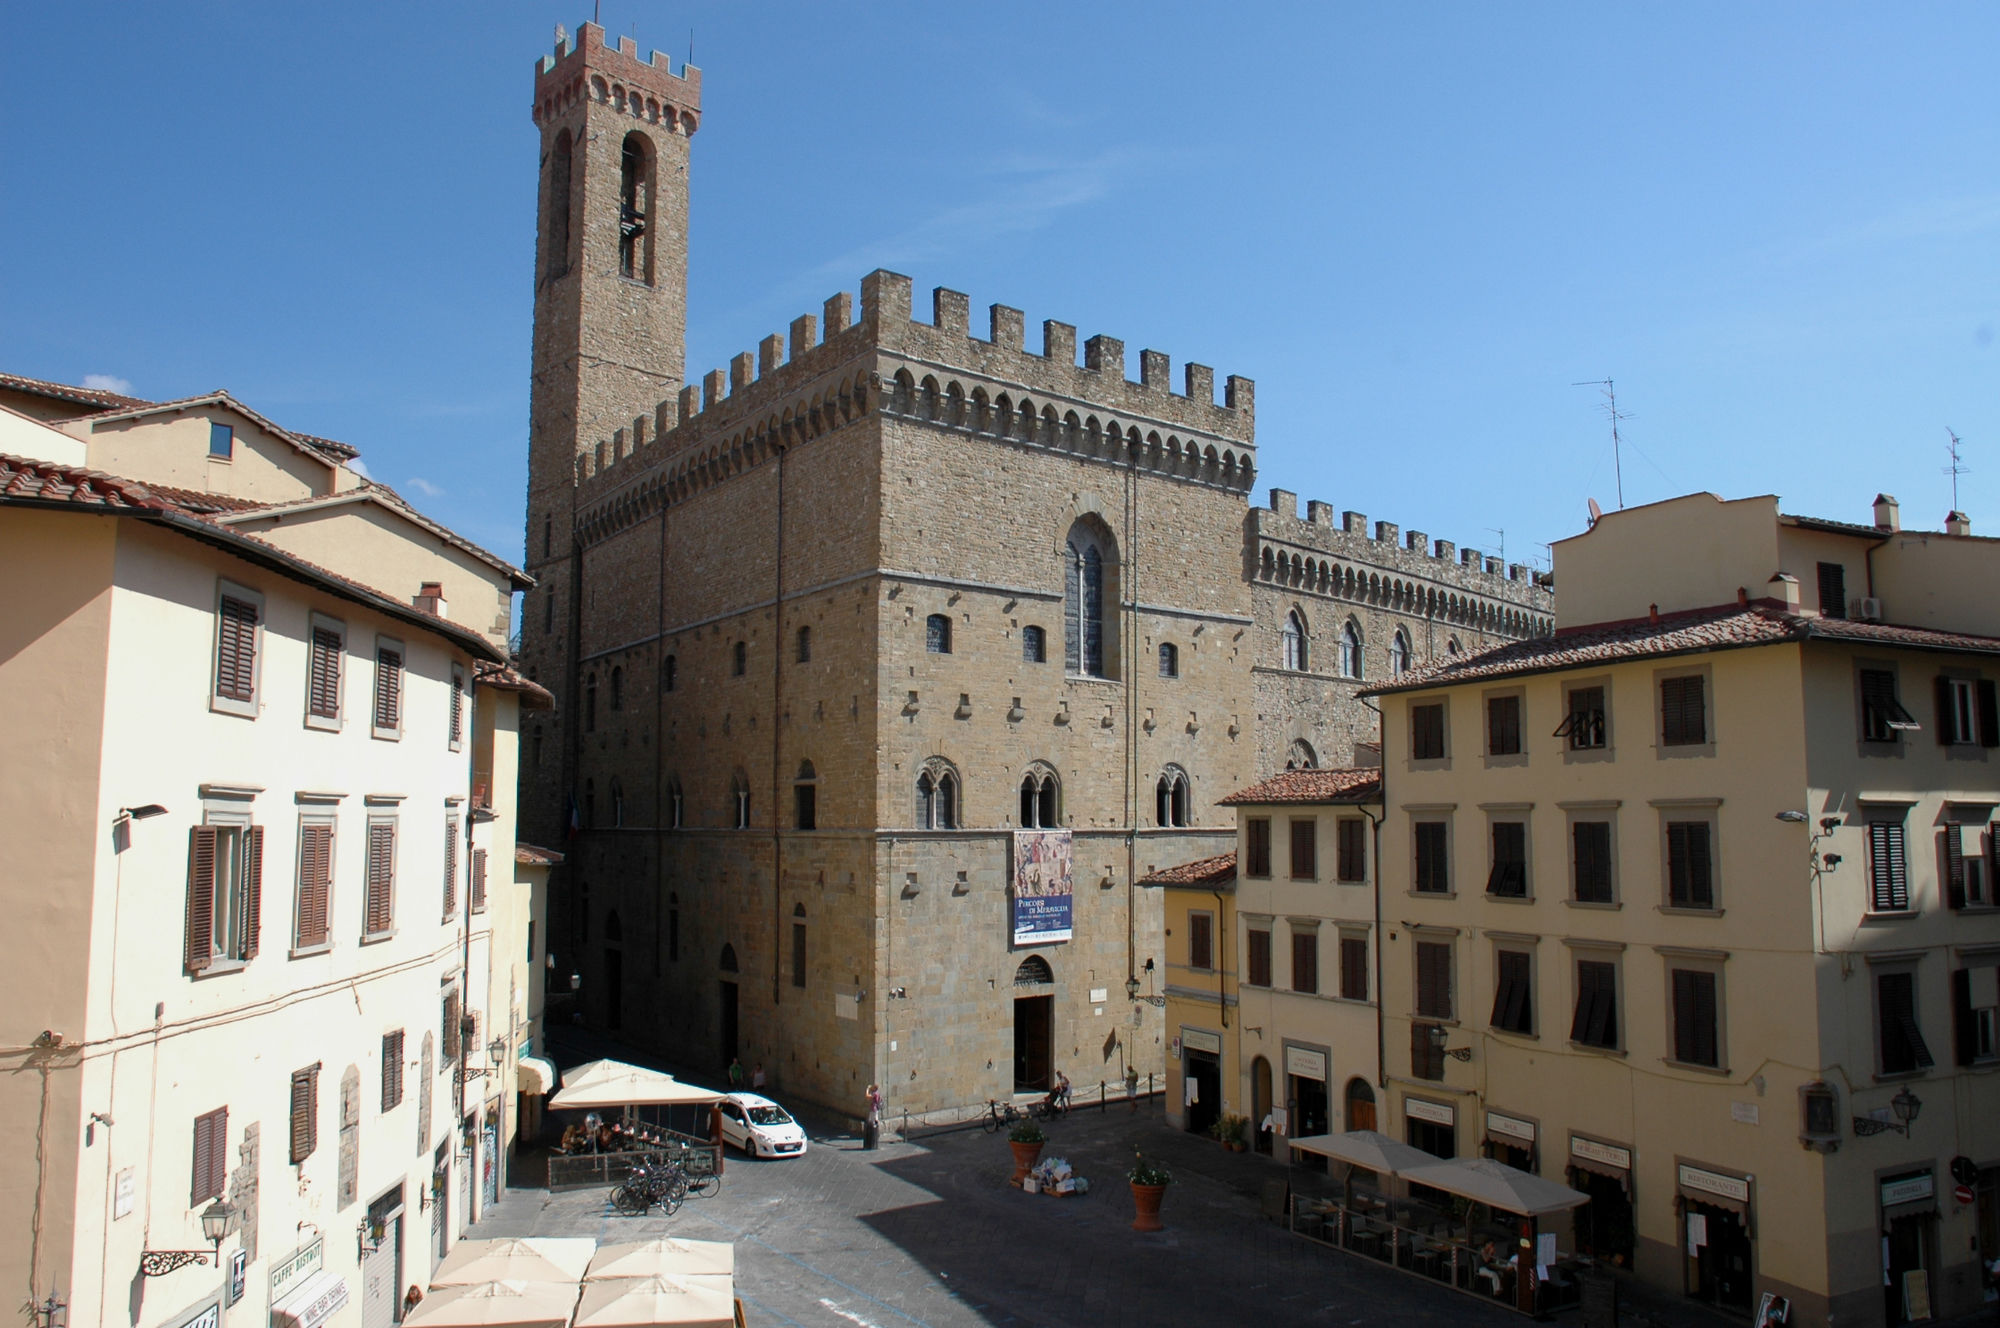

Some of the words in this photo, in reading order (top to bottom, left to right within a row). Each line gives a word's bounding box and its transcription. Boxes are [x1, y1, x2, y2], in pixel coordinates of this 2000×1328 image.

[1687, 1174, 1742, 1194] RISTORANTE
[296, 1244, 321, 1272] BISTROT
[305, 1304, 319, 1323] WINE
[317, 1296, 329, 1313] BAR
[328, 1282, 347, 1303] DRINKS
